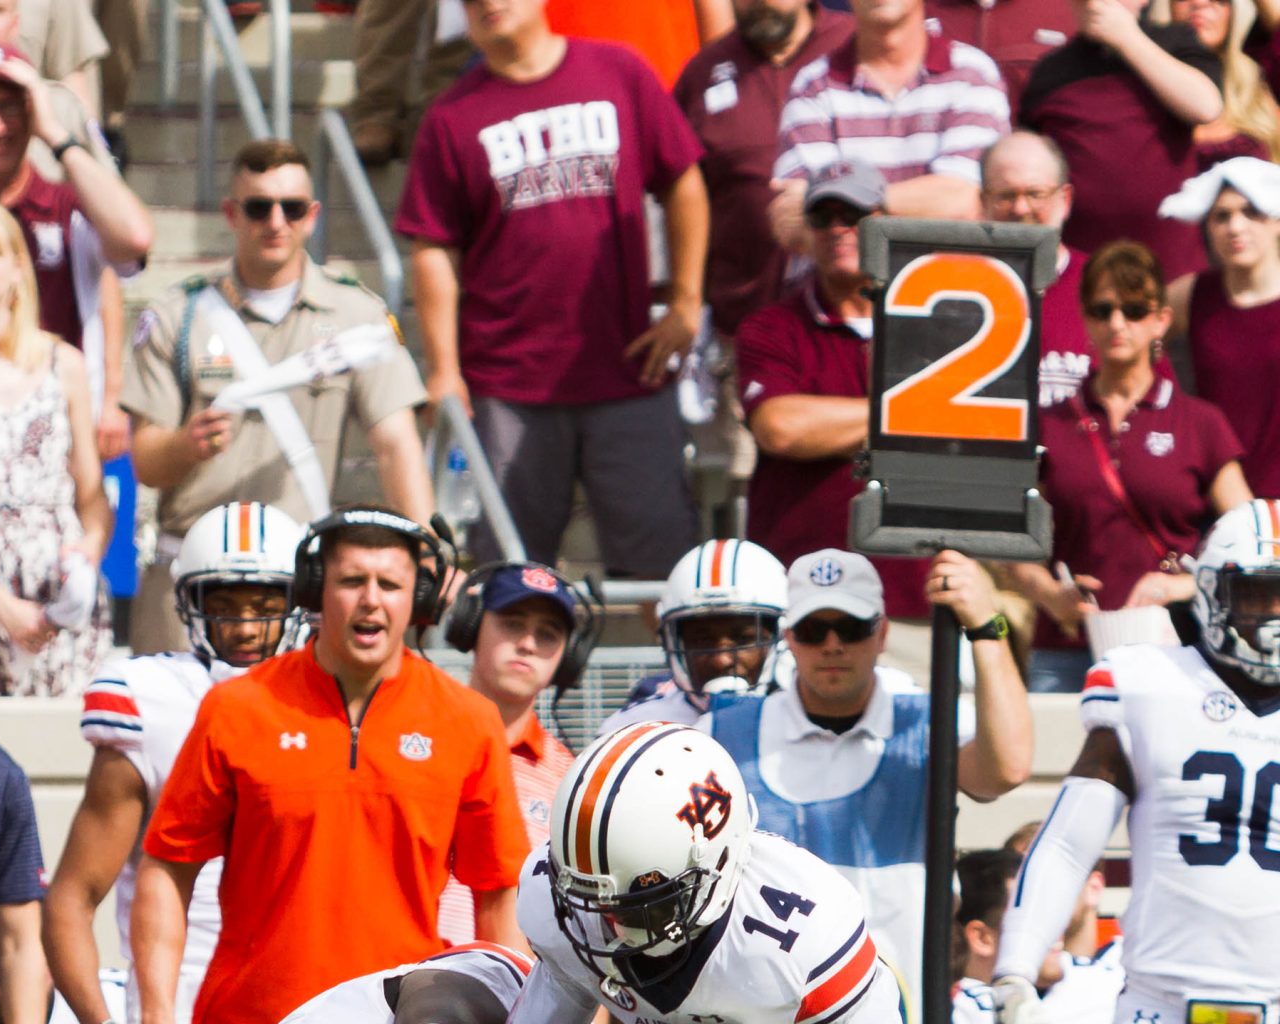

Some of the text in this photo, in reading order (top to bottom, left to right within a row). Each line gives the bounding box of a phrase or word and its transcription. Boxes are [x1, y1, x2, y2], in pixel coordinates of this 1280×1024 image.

[478, 101, 620, 178] BTHO
[881, 252, 1032, 442] 2
[742, 885, 817, 954] 14
